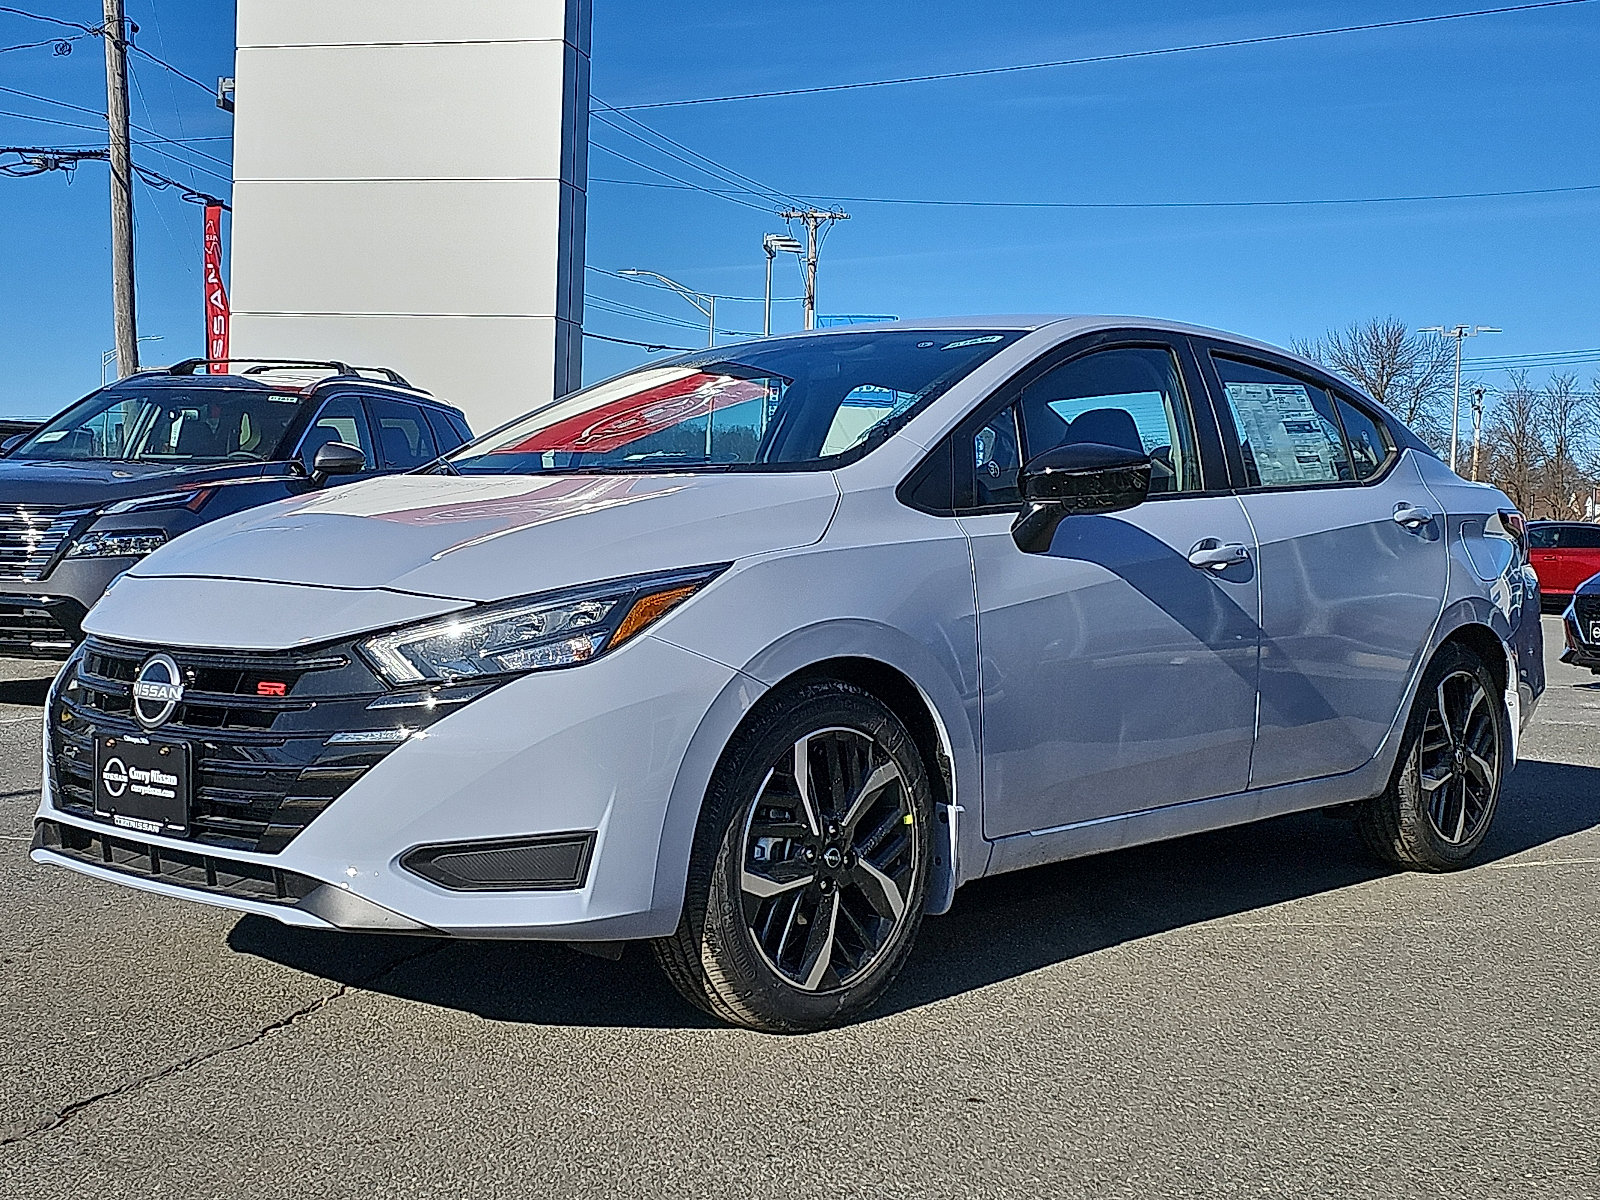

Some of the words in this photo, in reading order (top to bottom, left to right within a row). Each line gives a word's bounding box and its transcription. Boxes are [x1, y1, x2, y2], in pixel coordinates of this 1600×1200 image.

[133, 682, 183, 700] NISSAN
[257, 681, 286, 696] SR
[129, 767, 150, 784] Curry
[150, 770, 178, 785] Nissan
